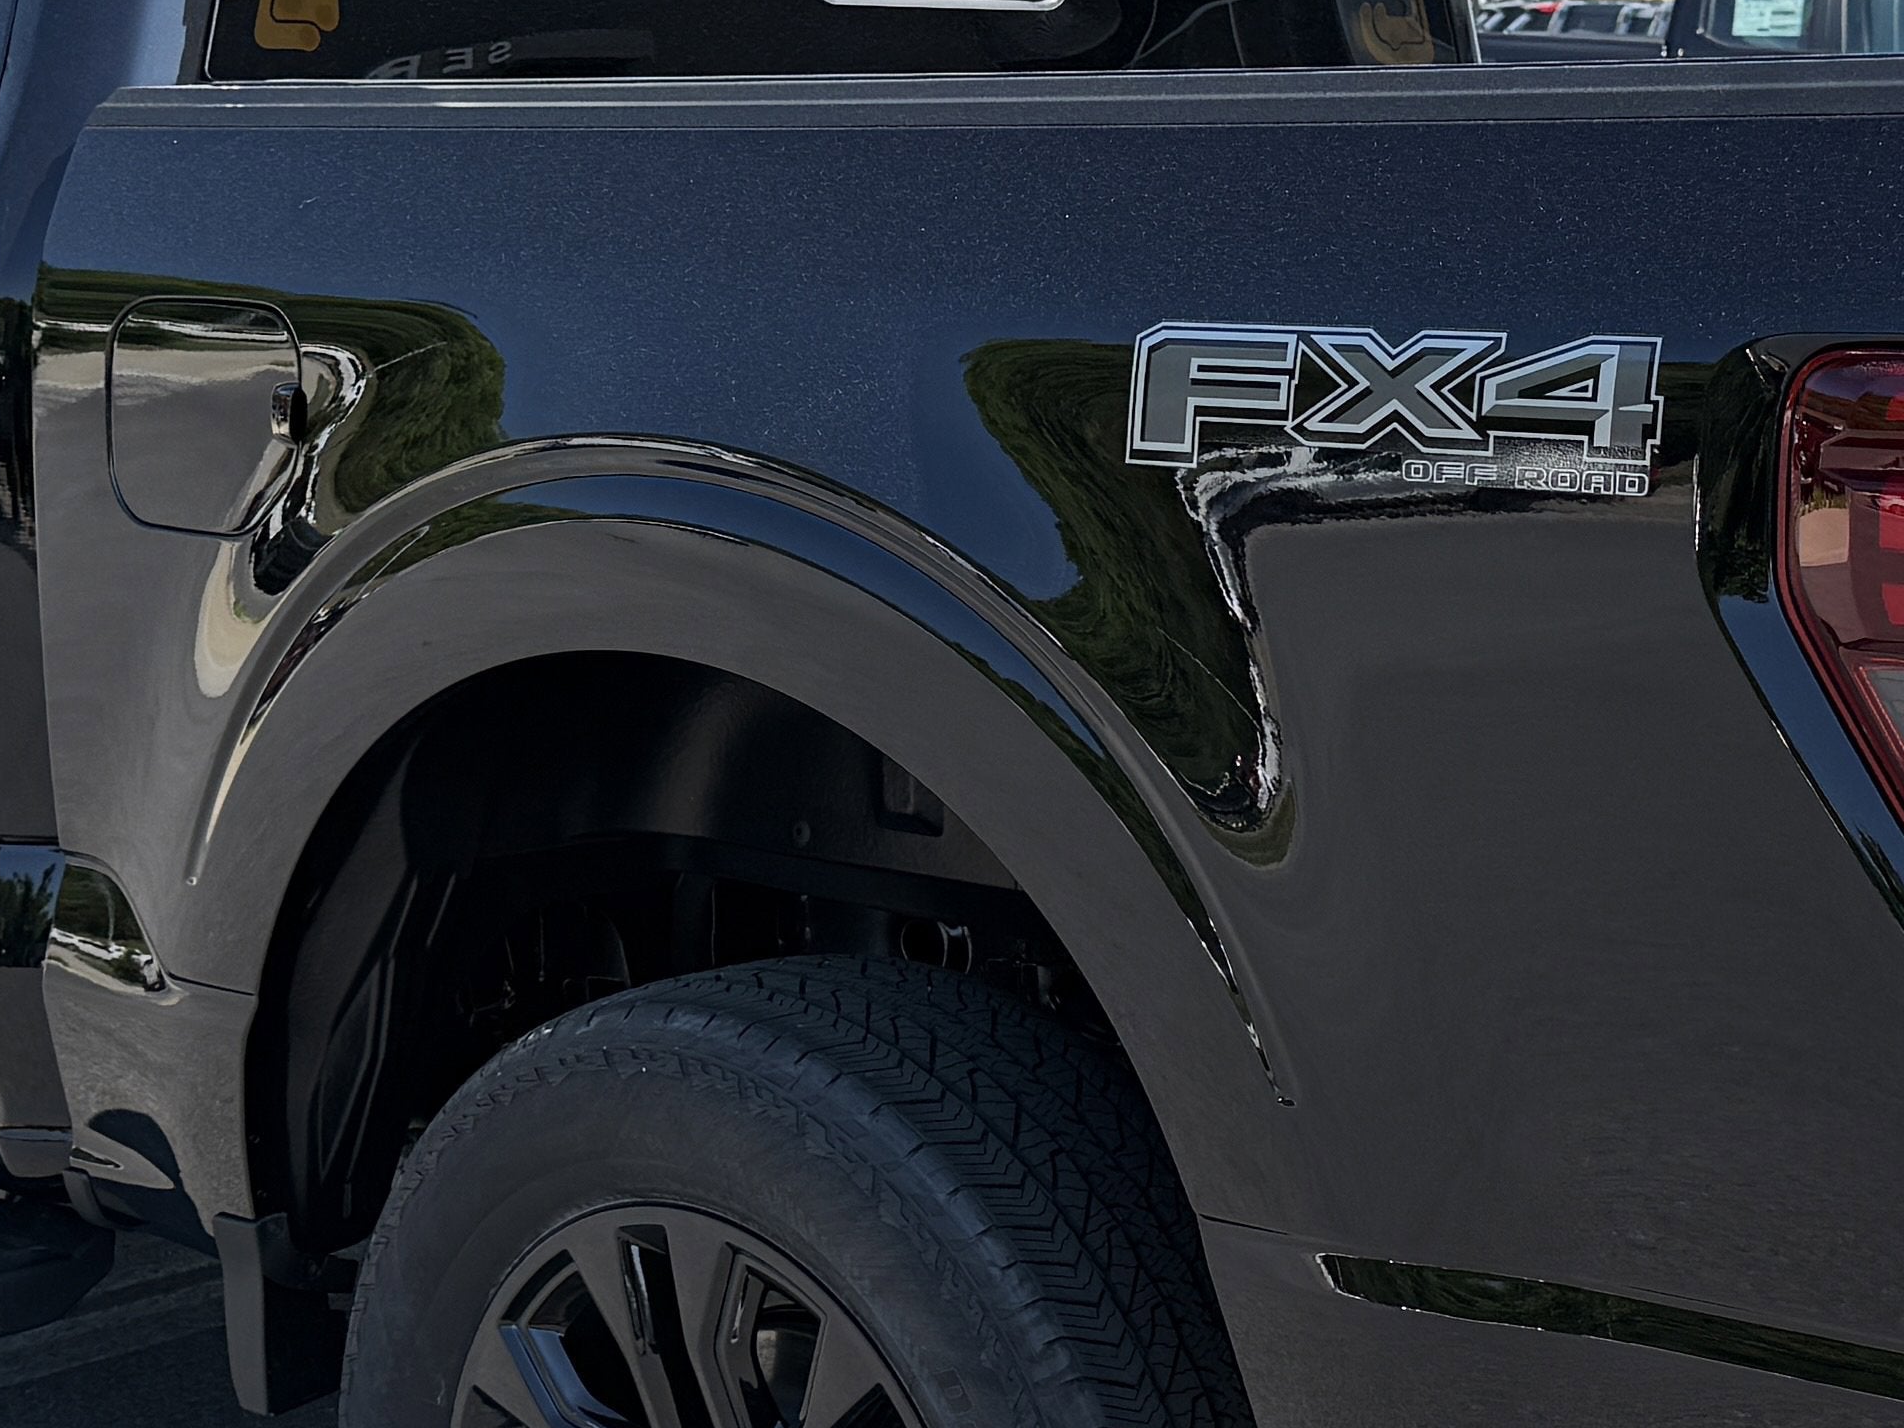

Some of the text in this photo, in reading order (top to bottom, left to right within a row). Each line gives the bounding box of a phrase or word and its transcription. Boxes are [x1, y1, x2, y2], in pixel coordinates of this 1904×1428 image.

[1125, 321, 1664, 468] FX4
[1402, 458, 1649, 498] OFF ROAD
